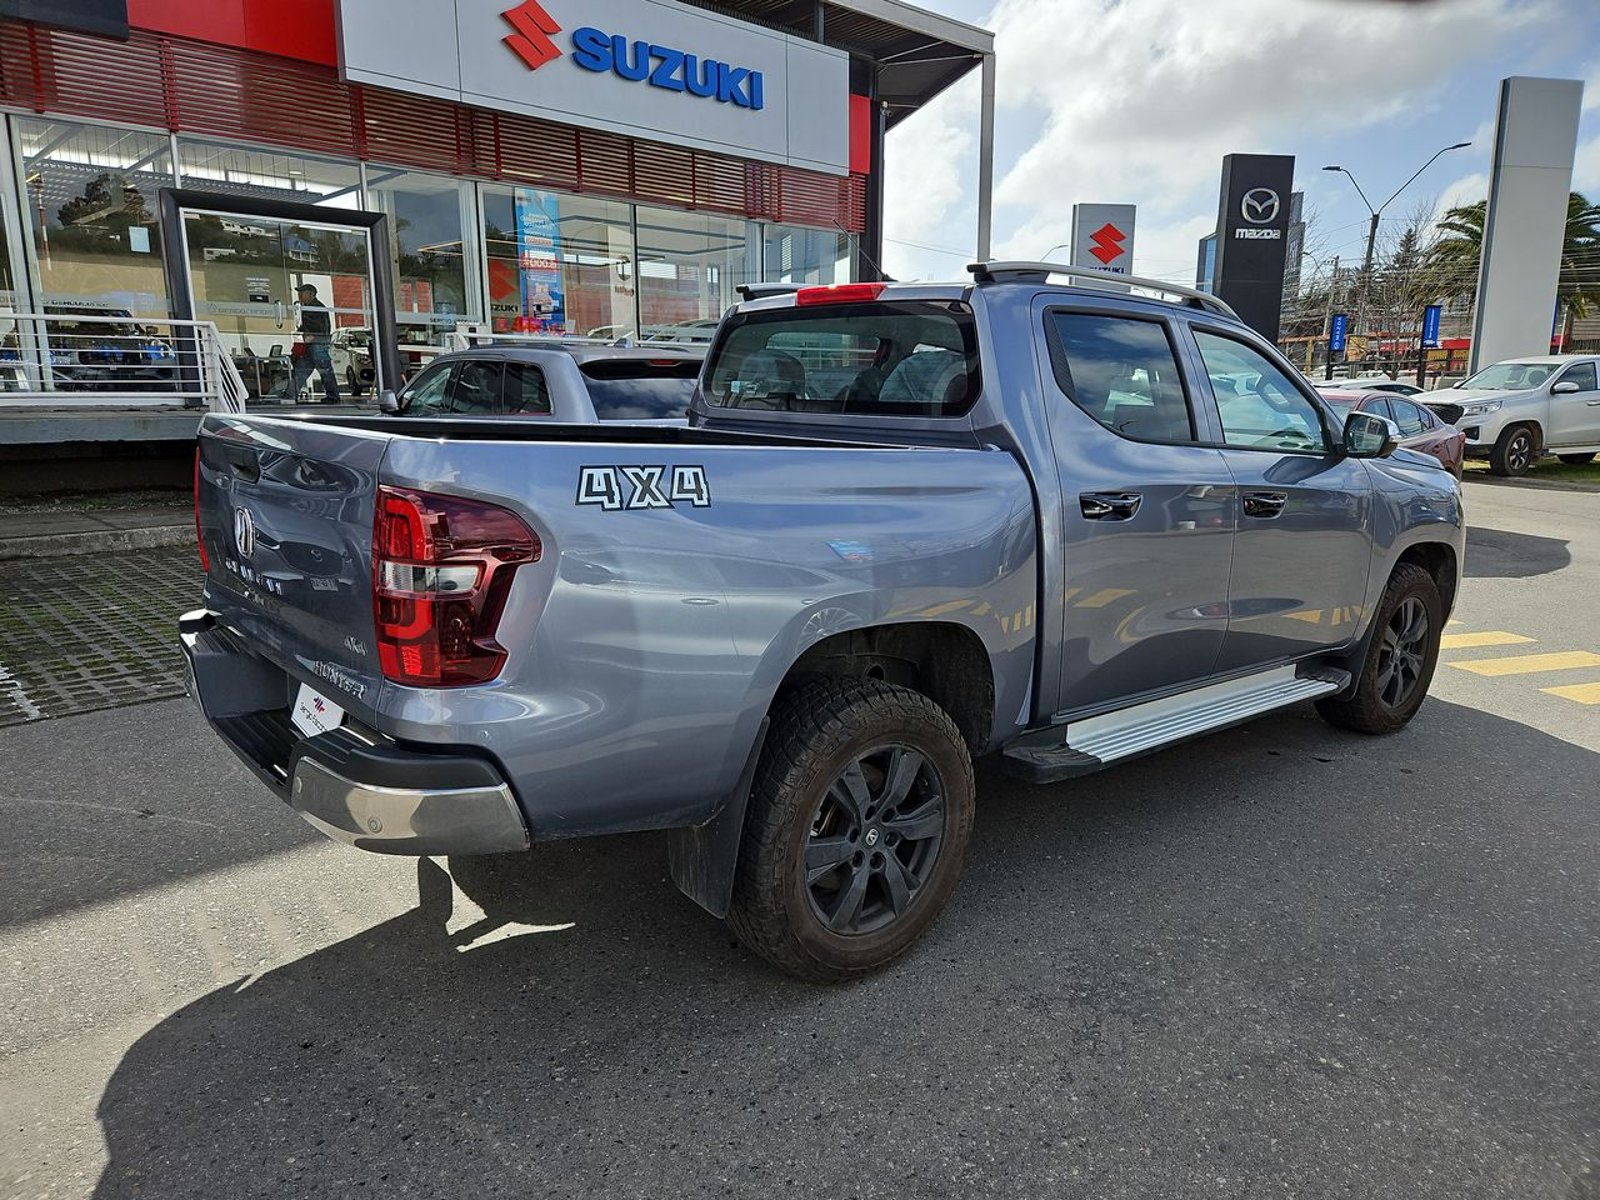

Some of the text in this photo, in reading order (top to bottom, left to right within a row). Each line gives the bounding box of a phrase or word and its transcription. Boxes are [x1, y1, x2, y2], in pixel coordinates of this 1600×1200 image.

[572, 27, 764, 110] SUZUKI
[575, 465, 712, 512] 4X4
[314, 660, 368, 699] HUNTER
